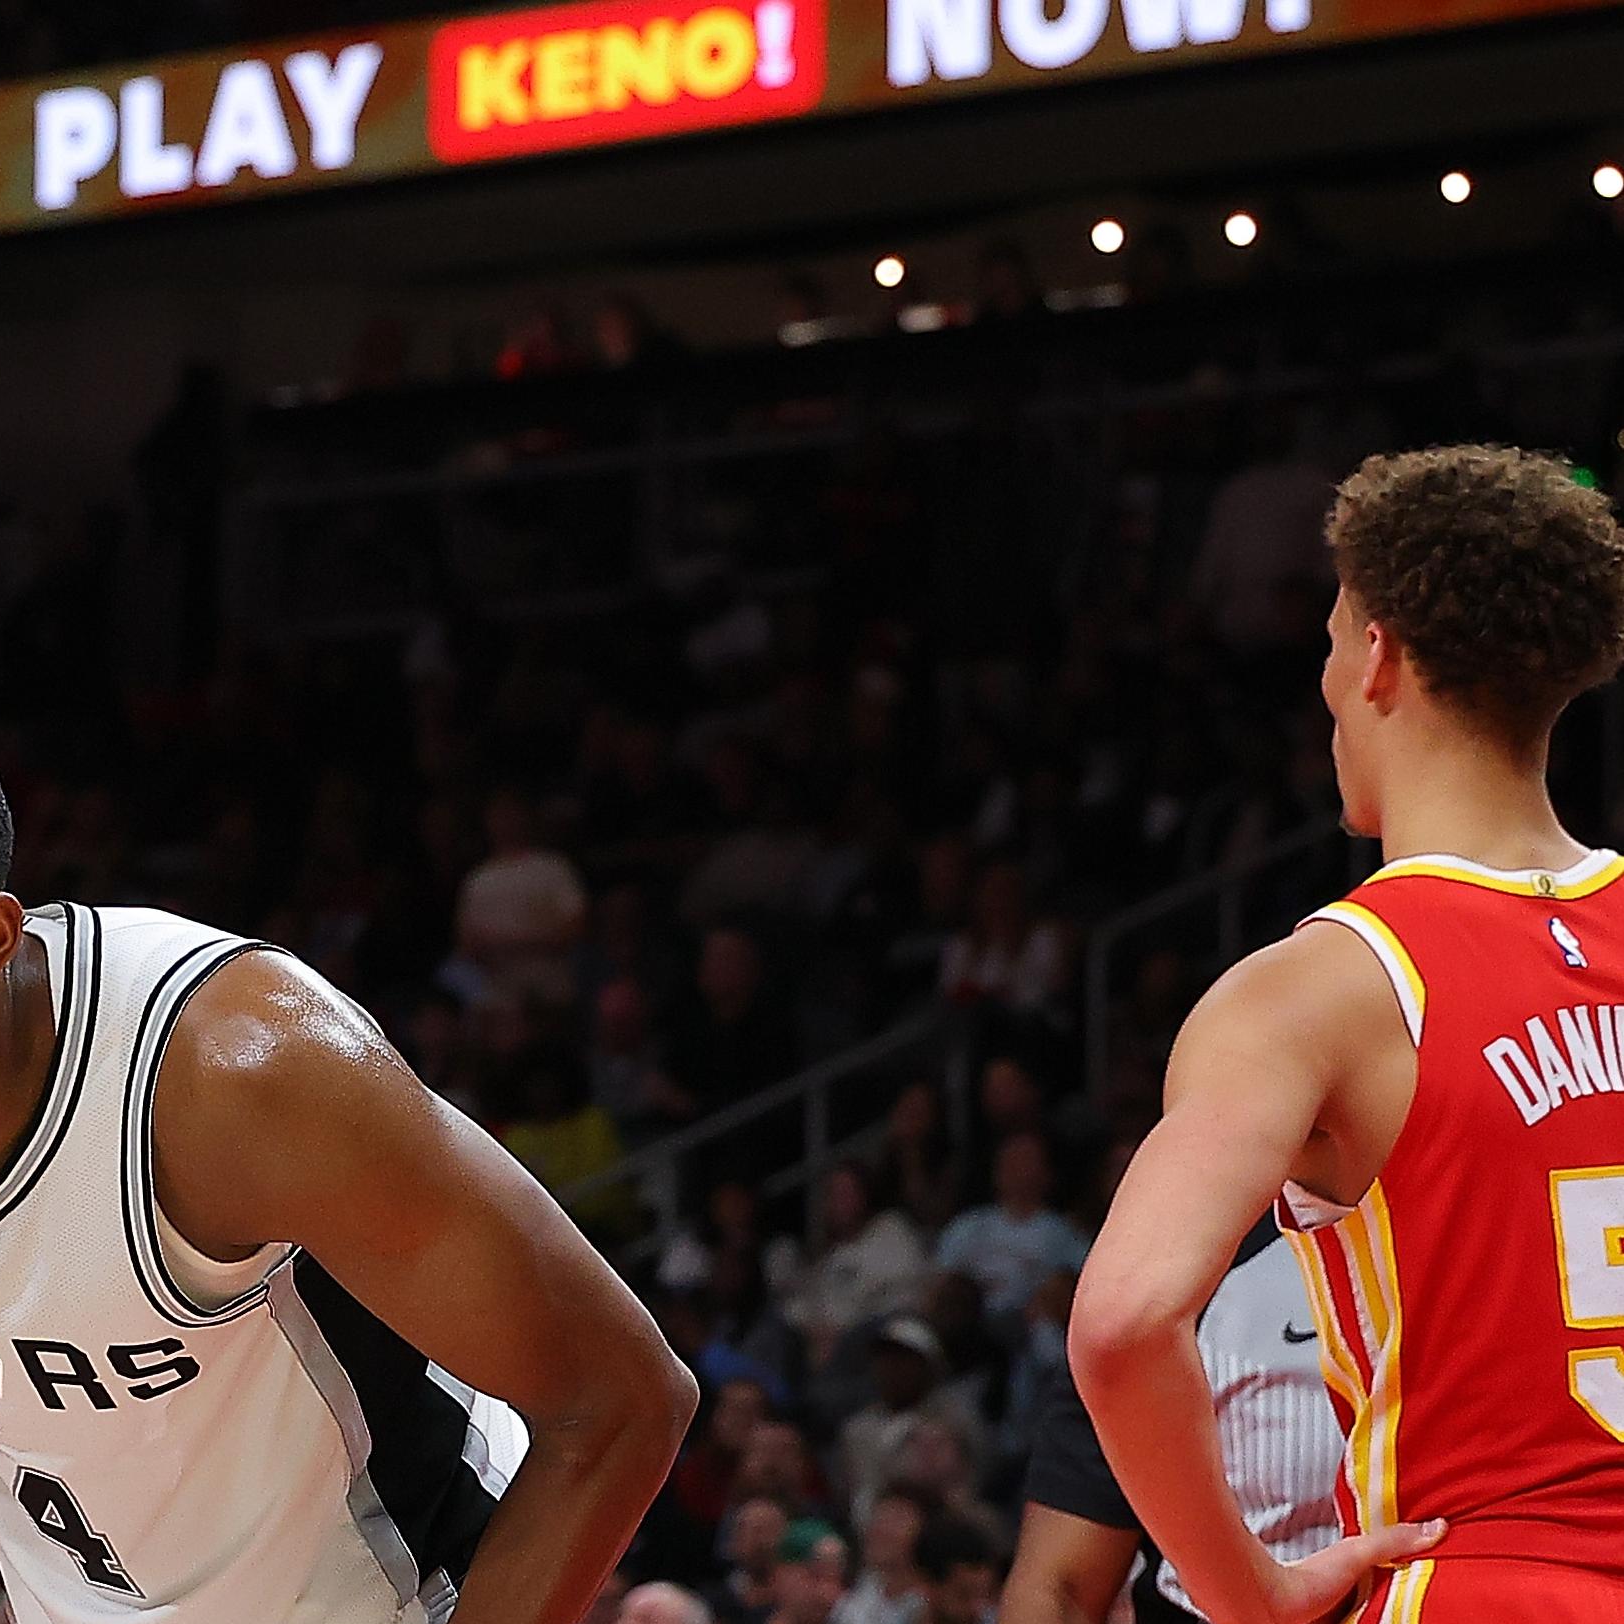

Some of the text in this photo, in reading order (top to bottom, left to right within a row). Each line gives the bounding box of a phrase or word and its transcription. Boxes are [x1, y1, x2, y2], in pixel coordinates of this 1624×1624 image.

[33, 42, 383, 210] PLAY
[456, 4, 796, 132] KENO!
[1482, 1004, 1624, 1128] DANI
[1550, 1163, 1624, 1443] 5
[11, 1464, 147, 1600] 4
